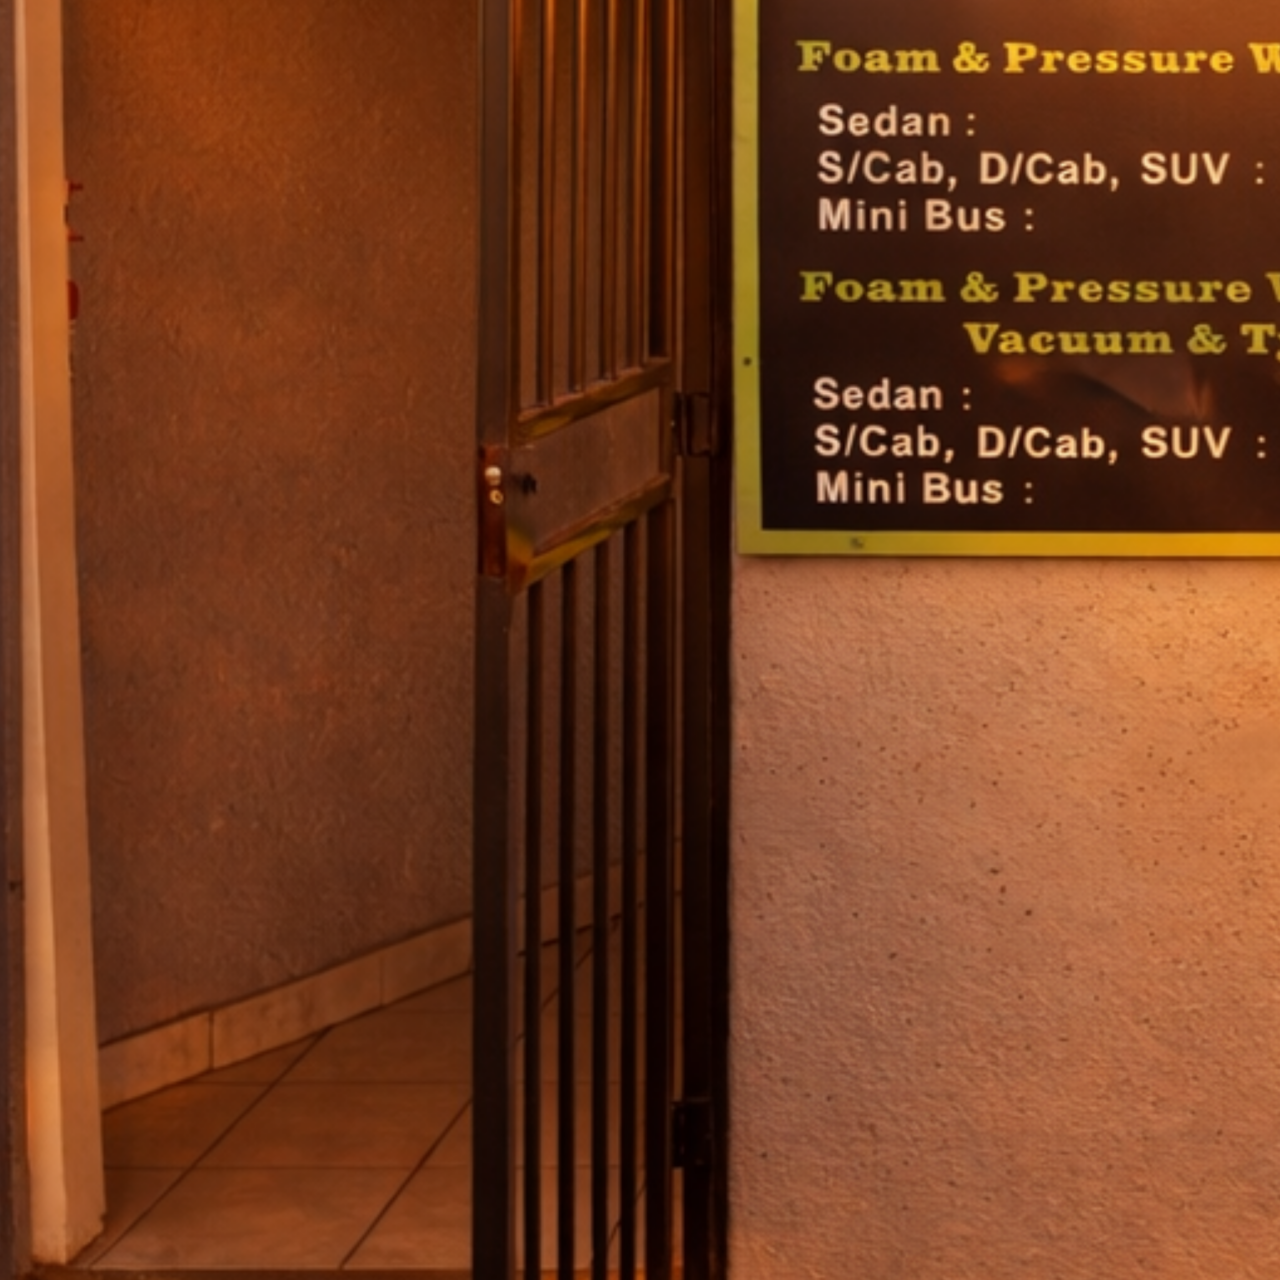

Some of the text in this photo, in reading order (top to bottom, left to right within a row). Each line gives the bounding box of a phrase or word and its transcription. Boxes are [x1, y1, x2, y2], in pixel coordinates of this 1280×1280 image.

[798, 42, 941, 73] Foam
[954, 43, 990, 73] &
[1004, 43, 1235, 74] Pressure
[819, 104, 951, 138] Sedan
[819, 151, 958, 192] S/Cab,
[980, 152, 1120, 192] D/Cab,
[1141, 152, 1232, 186] SUV
[819, 198, 908, 232] Mini
[926, 199, 1007, 233] Bus
[801, 272, 946, 304] Foam
[960, 273, 1000, 304] &
[1014, 272, 1253, 304] Pressure
[964, 323, 1175, 356] Vacuum
[1187, 324, 1228, 356] &
[814, 378, 943, 412] Sedan
[815, 425, 955, 465] S/Cab,
[979, 426, 1119, 466] D/Cab,
[1142, 426, 1232, 460] SUV
[817, 471, 906, 505] Mini
[923, 472, 1005, 506] Bus
